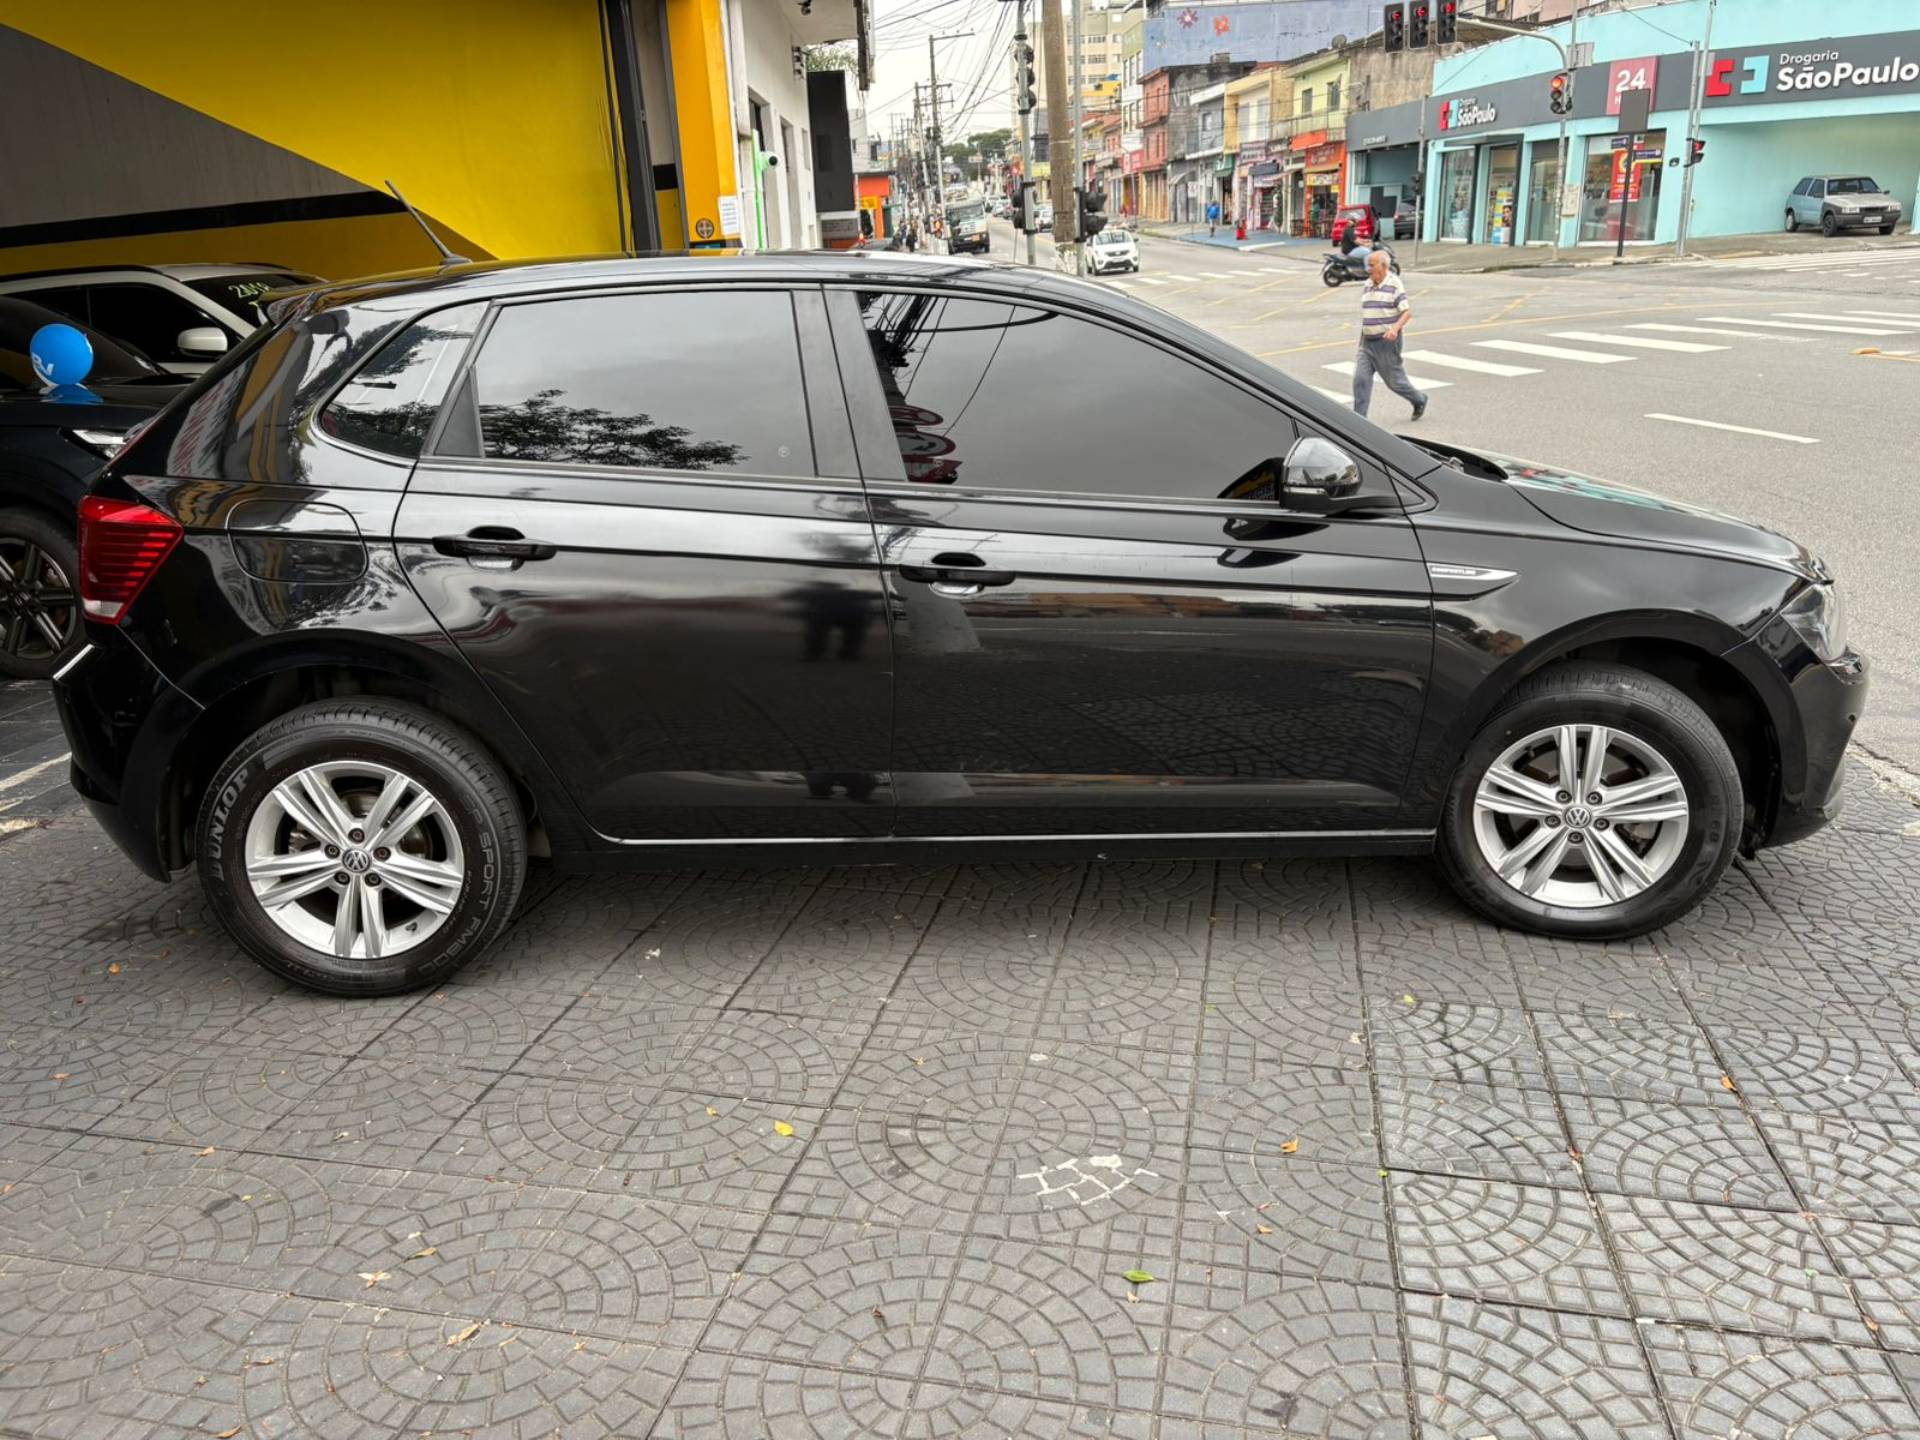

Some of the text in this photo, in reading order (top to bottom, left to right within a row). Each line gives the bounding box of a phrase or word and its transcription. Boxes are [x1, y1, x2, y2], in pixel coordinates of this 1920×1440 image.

[1776, 56, 1920, 92] SãoPaulo
[1780, 50, 1839, 65] Drogaria
[1616, 68, 1646, 93] 24
[207, 767, 249, 881] DUNLOP
[479, 831, 496, 911] SPORT
